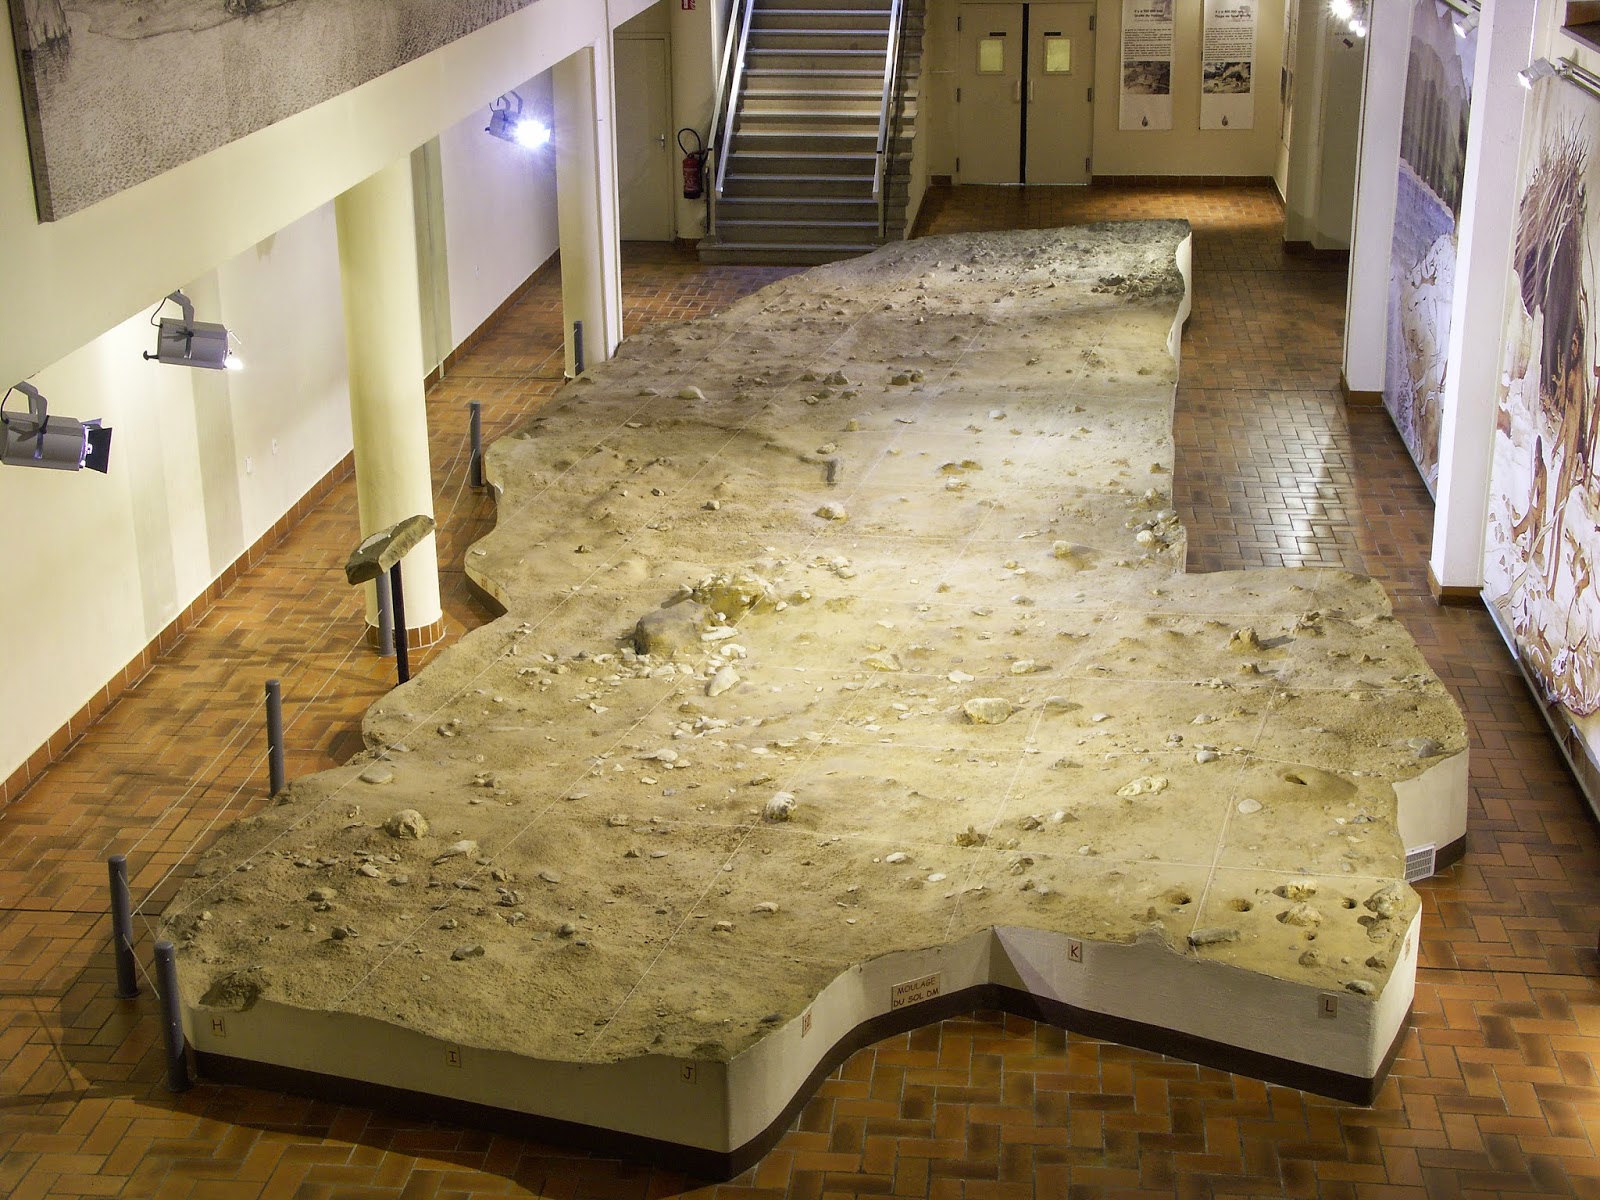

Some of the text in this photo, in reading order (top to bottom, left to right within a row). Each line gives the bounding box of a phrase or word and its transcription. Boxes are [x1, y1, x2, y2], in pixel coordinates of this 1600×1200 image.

[1071, 945, 1079, 958] K
[896, 976, 936, 995] MOULAGE
[893, 987, 939, 1008] DU SOL DM
[1326, 999, 1334, 1012] L
[212, 1018, 223, 1032] H
[448, 1050, 457, 1063] I
[683, 1066, 693, 1080] J
